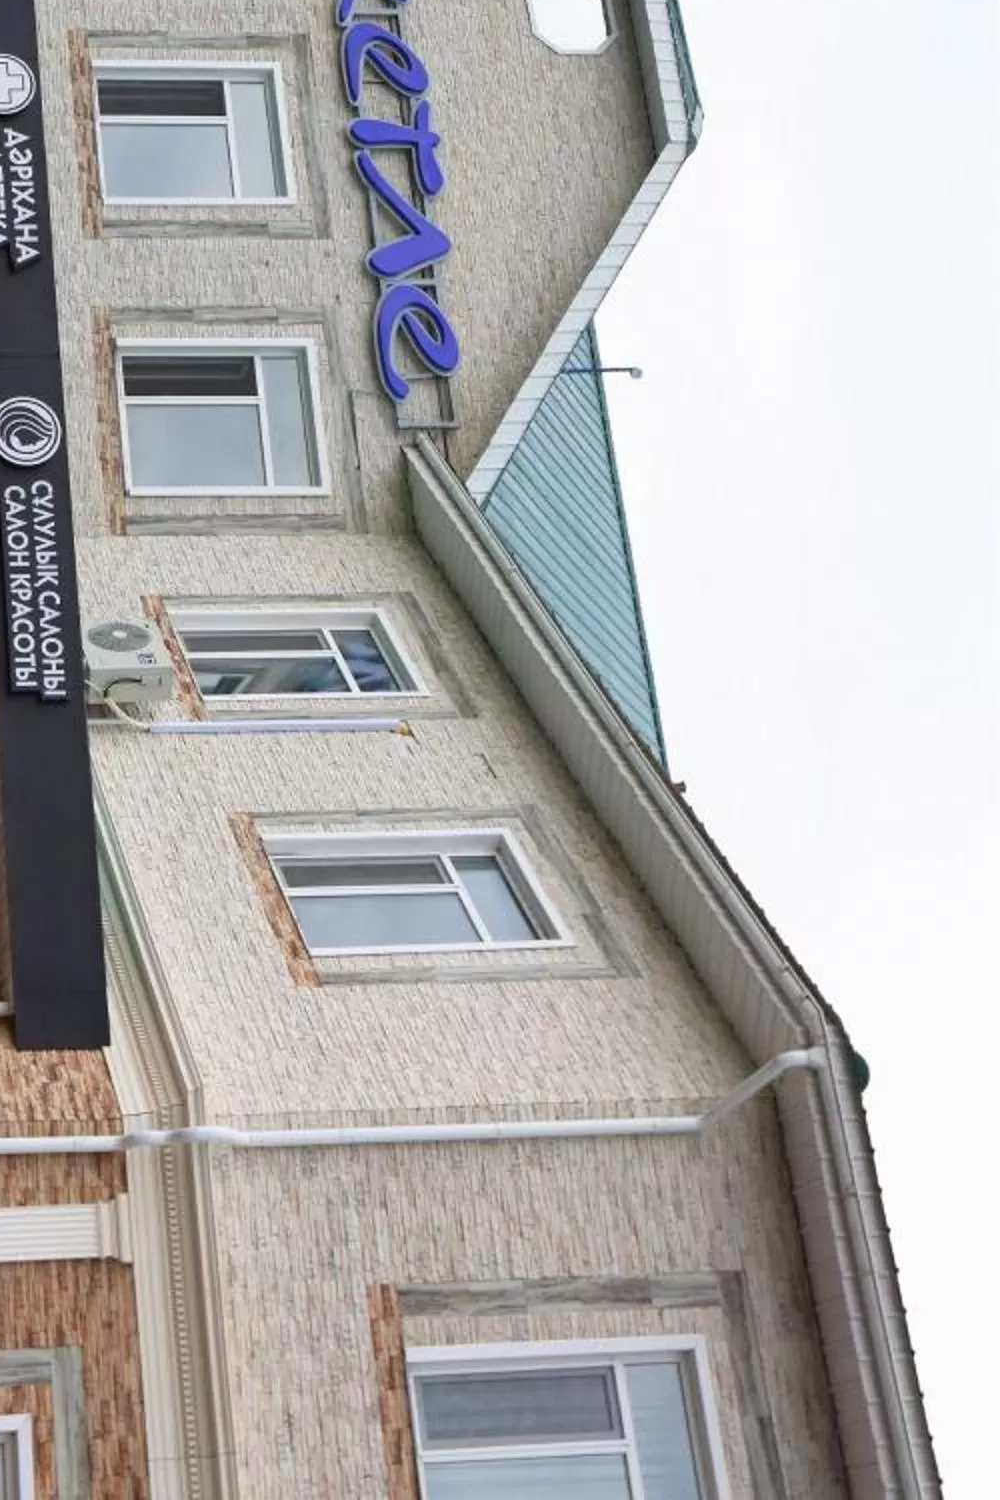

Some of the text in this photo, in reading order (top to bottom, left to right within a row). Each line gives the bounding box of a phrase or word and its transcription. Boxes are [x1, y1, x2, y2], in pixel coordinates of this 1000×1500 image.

[3, 127, 41, 263] ДӘРІХАНА
[3, 485, 39, 687] САЛОН КРАСОТЫ
[31, 480, 67, 697] СҰЛУЛЫҚ САЛОНЫ
